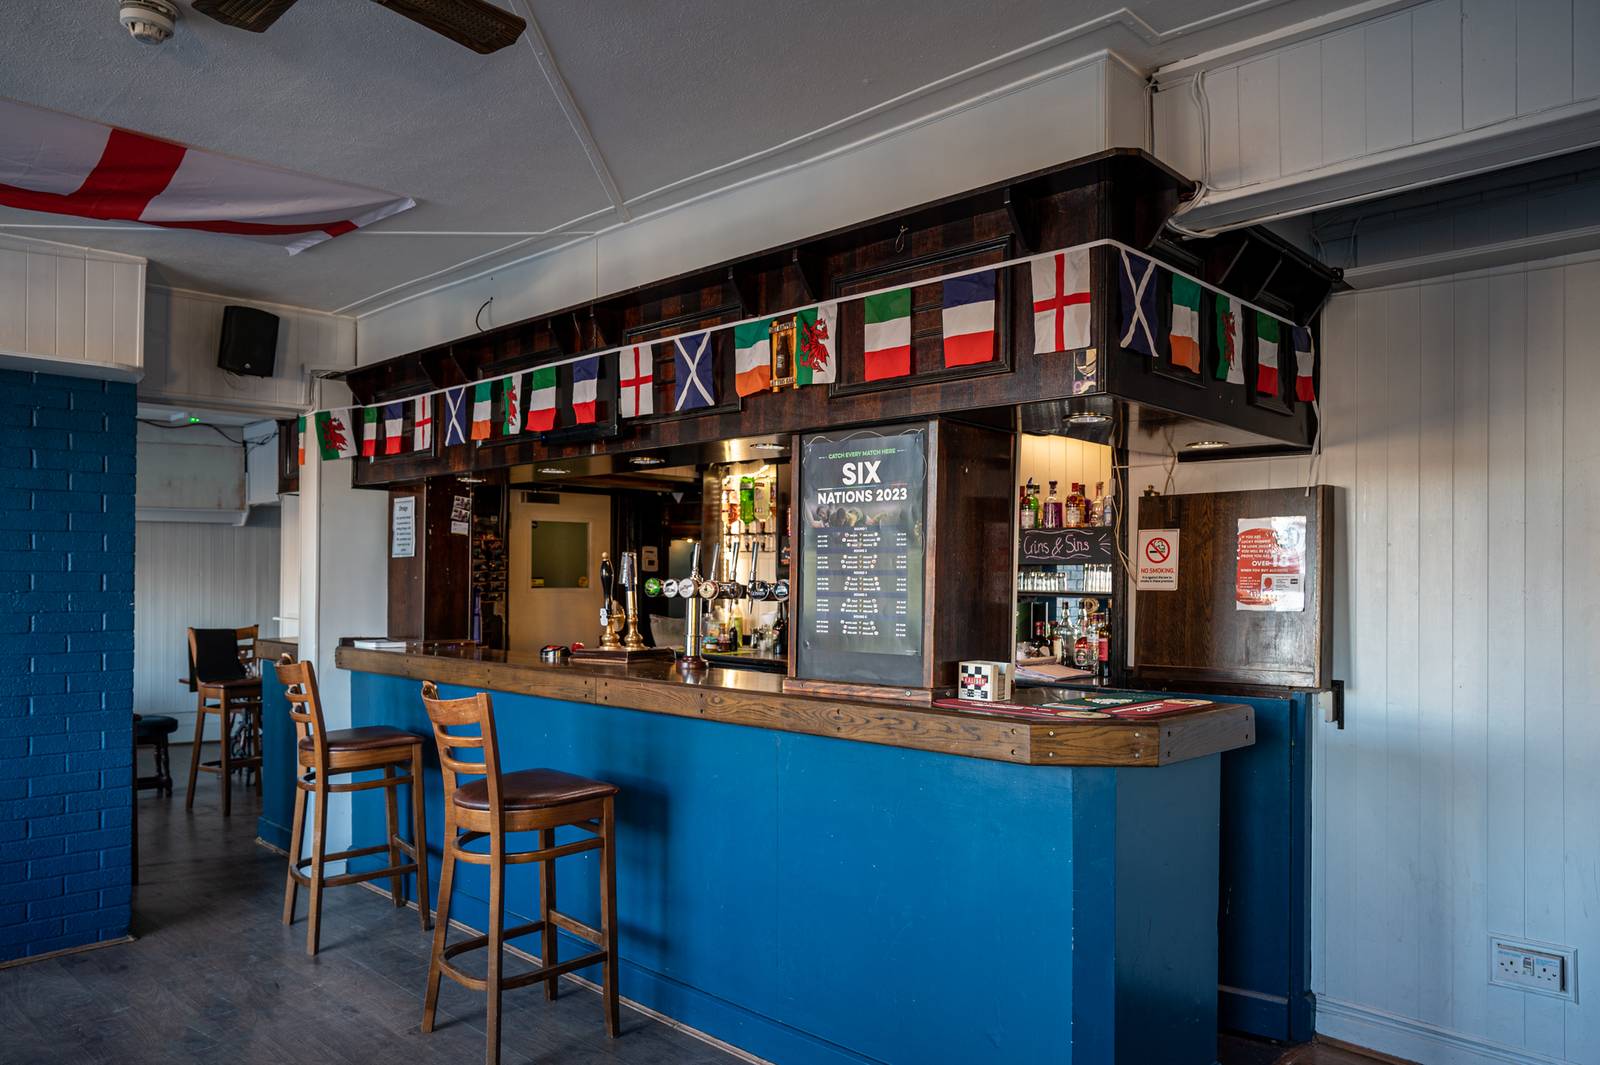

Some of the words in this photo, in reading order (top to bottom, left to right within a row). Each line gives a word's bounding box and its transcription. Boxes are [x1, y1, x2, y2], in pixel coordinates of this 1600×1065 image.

[828, 452, 845, 460] CATCH
[862, 449, 881, 457] MATCH
[842, 460, 881, 486] SIX
[817, 490, 873, 505] NATIONS
[876, 487, 908, 502] 2023
[1023, 535, 1050, 555] Gins
[1051, 536, 1063, 557] &
[1065, 534, 1090, 553] Sins
